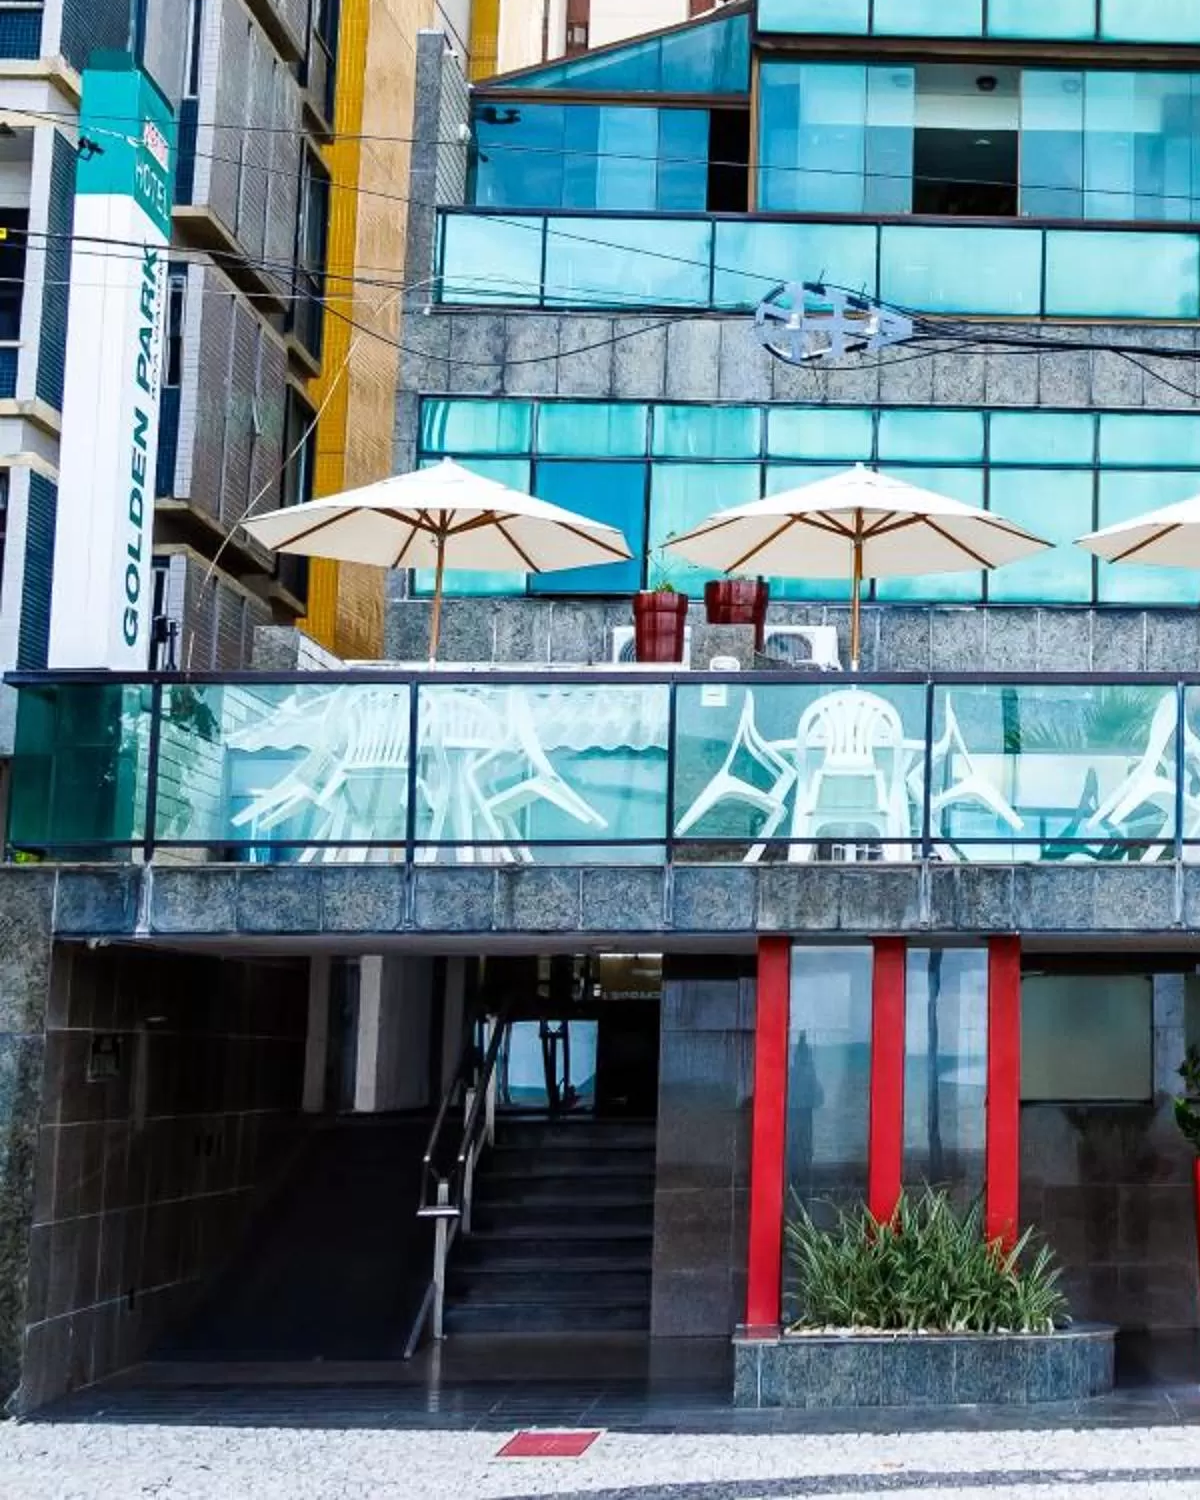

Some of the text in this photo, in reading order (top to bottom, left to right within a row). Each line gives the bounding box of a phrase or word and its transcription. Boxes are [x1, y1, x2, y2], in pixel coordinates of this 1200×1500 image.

[135, 164, 168, 220] HOTEL
[123, 407, 149, 646] GOLDEN
[136, 243, 158, 394] PARK
